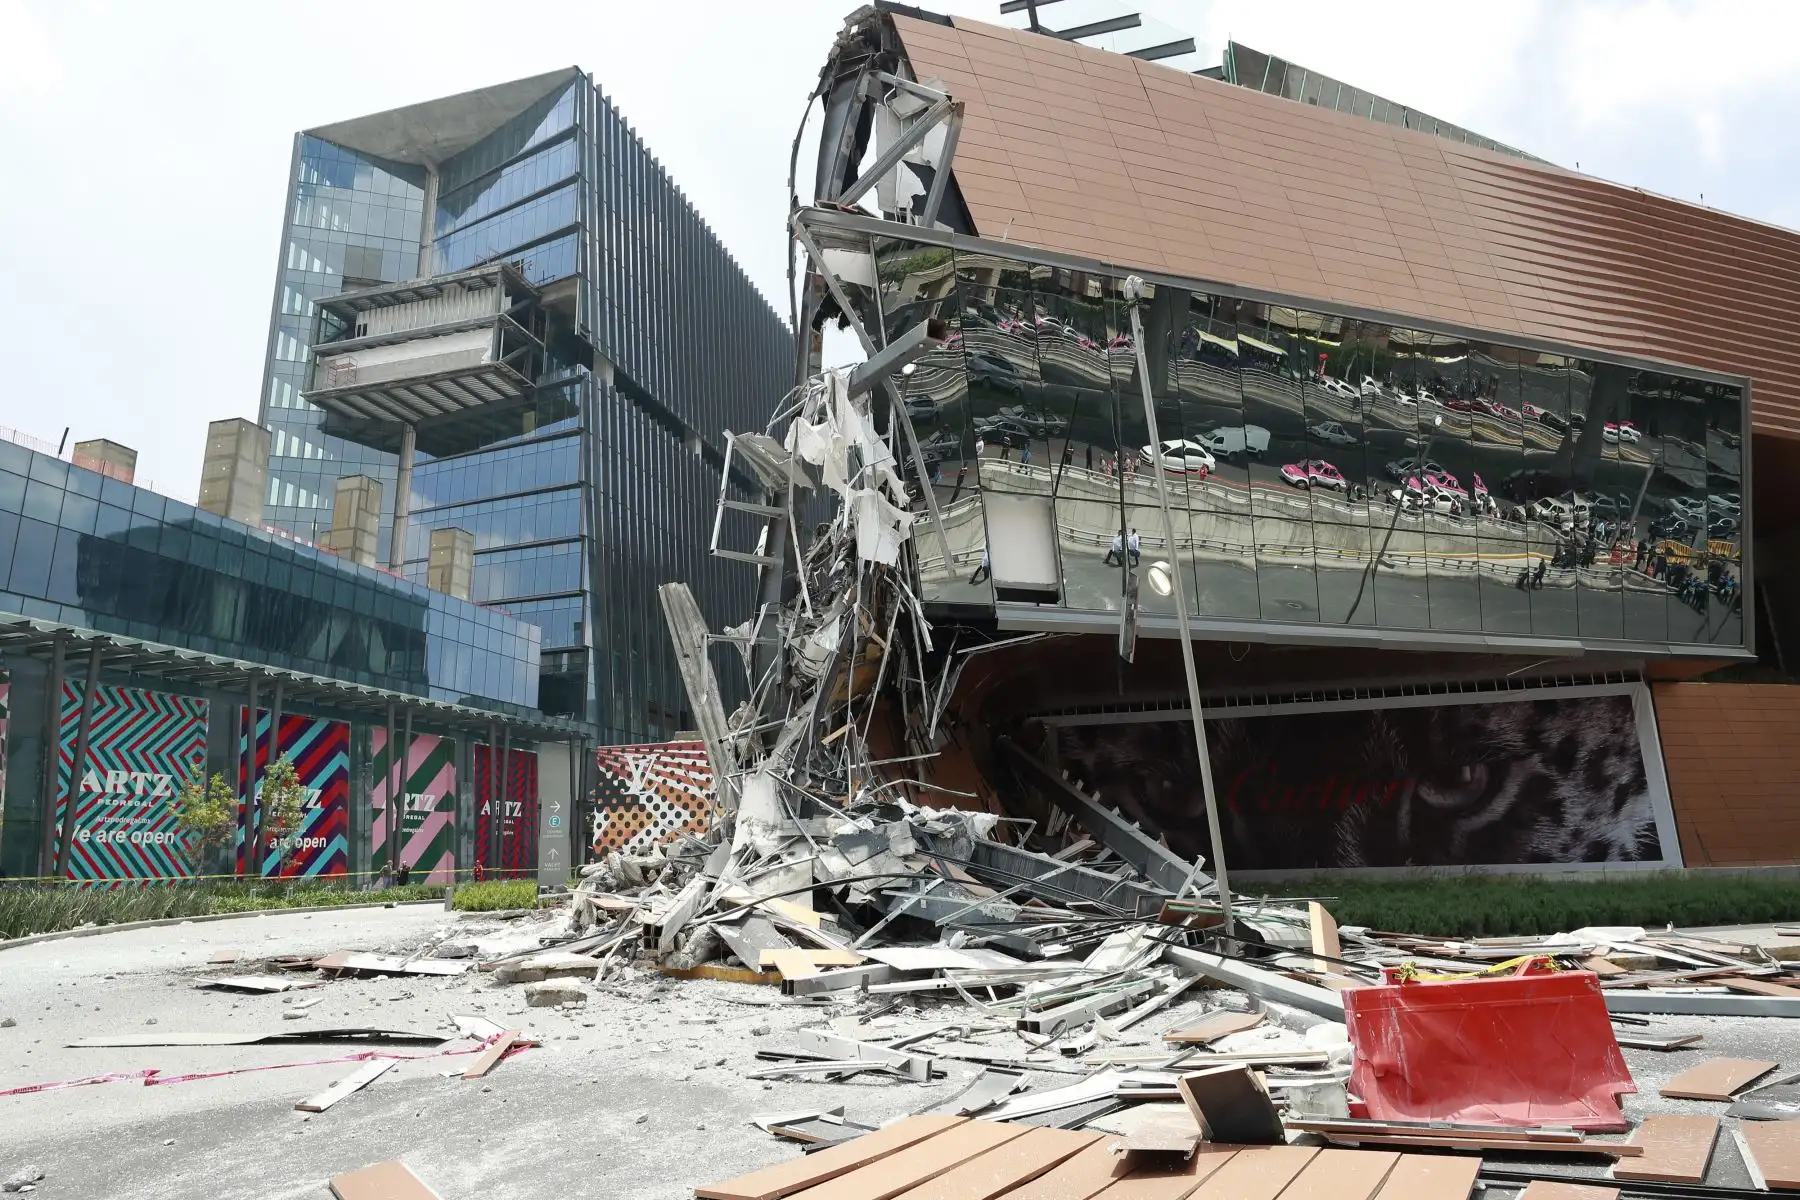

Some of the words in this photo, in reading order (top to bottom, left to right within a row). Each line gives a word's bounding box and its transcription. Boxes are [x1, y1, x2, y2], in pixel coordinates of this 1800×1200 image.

[80, 768, 173, 796] ARTZ
[97, 798, 153, 807] PEDREGAL
[95, 829, 126, 843] are
[131, 831, 175, 849] open
[269, 838, 291, 849] are
[294, 836, 327, 852] open
